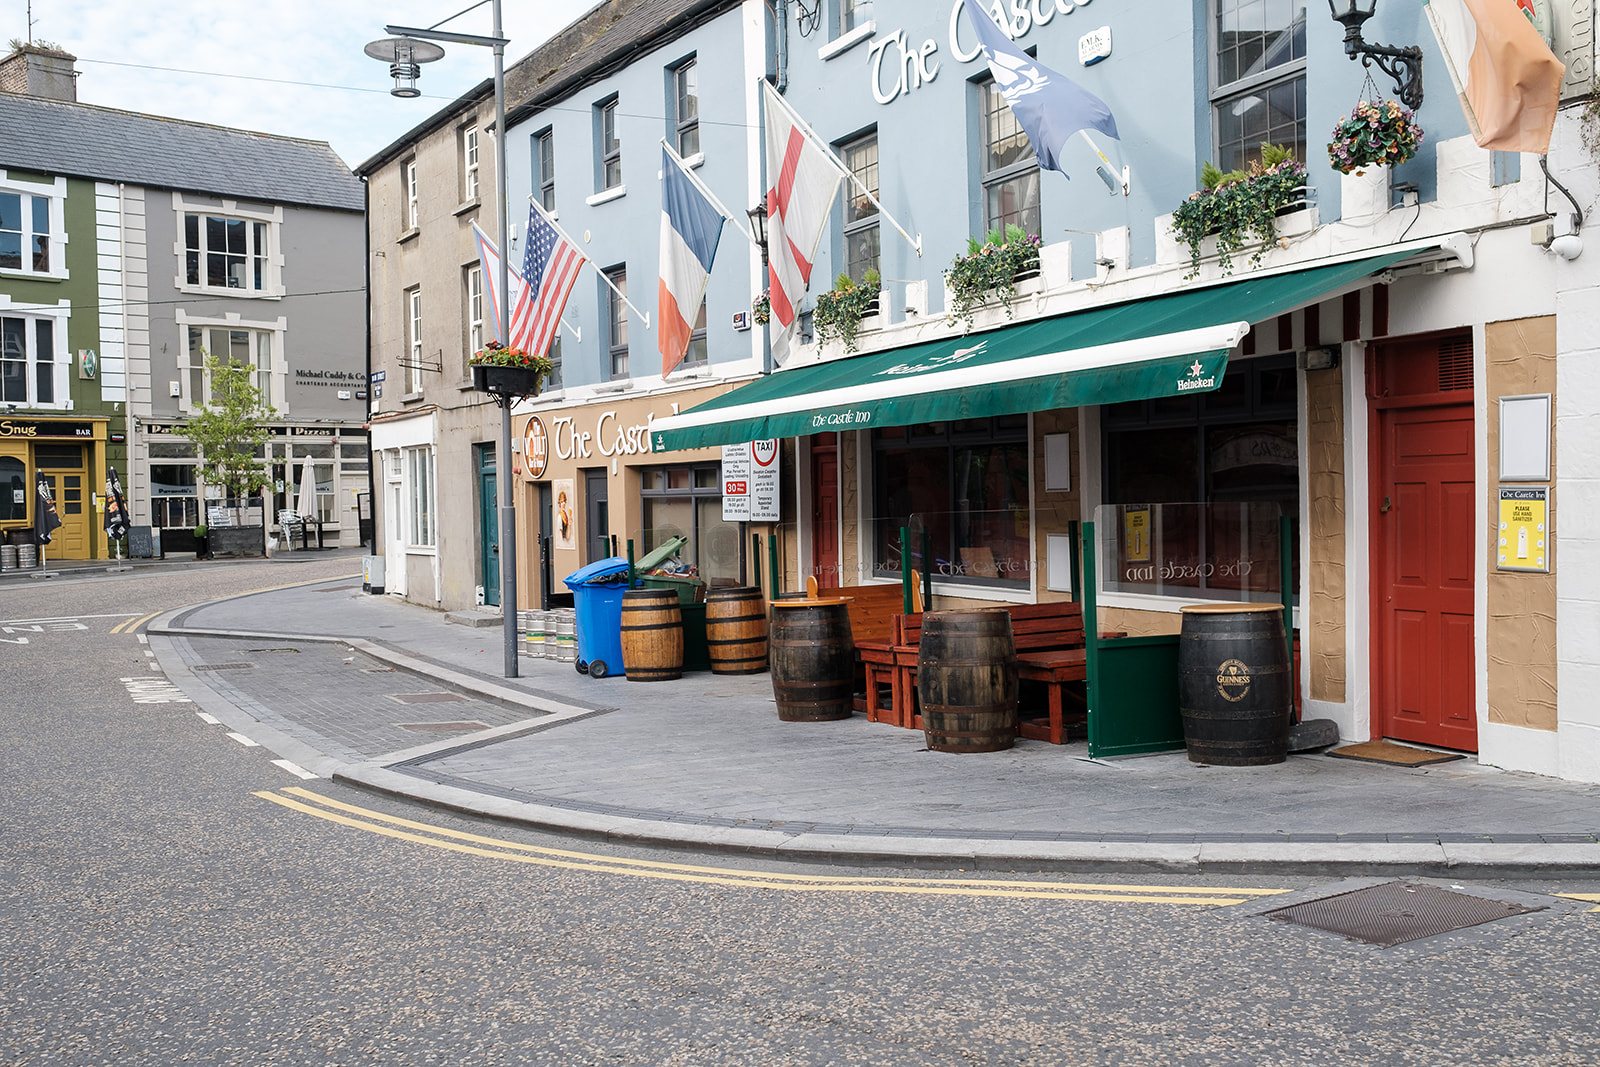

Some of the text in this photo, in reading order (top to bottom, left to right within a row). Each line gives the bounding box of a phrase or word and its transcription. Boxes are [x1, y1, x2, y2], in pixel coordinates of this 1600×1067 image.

[866, 28, 942, 104] The
[296, 370, 323, 378] Michael
[324, 371, 346, 381] Cuddy
[347, 372, 354, 380] &
[355, 372, 367, 380] Co.
[1177, 377, 1214, 391] Heineken
[0, 420, 38, 437] Snug
[295, 427, 331, 435] Pizzas
[552, 416, 592, 460] The
[756, 442, 773, 451] TAXI
[727, 483, 737, 493] 30
[1216, 674, 1250, 684] GUINNESS
